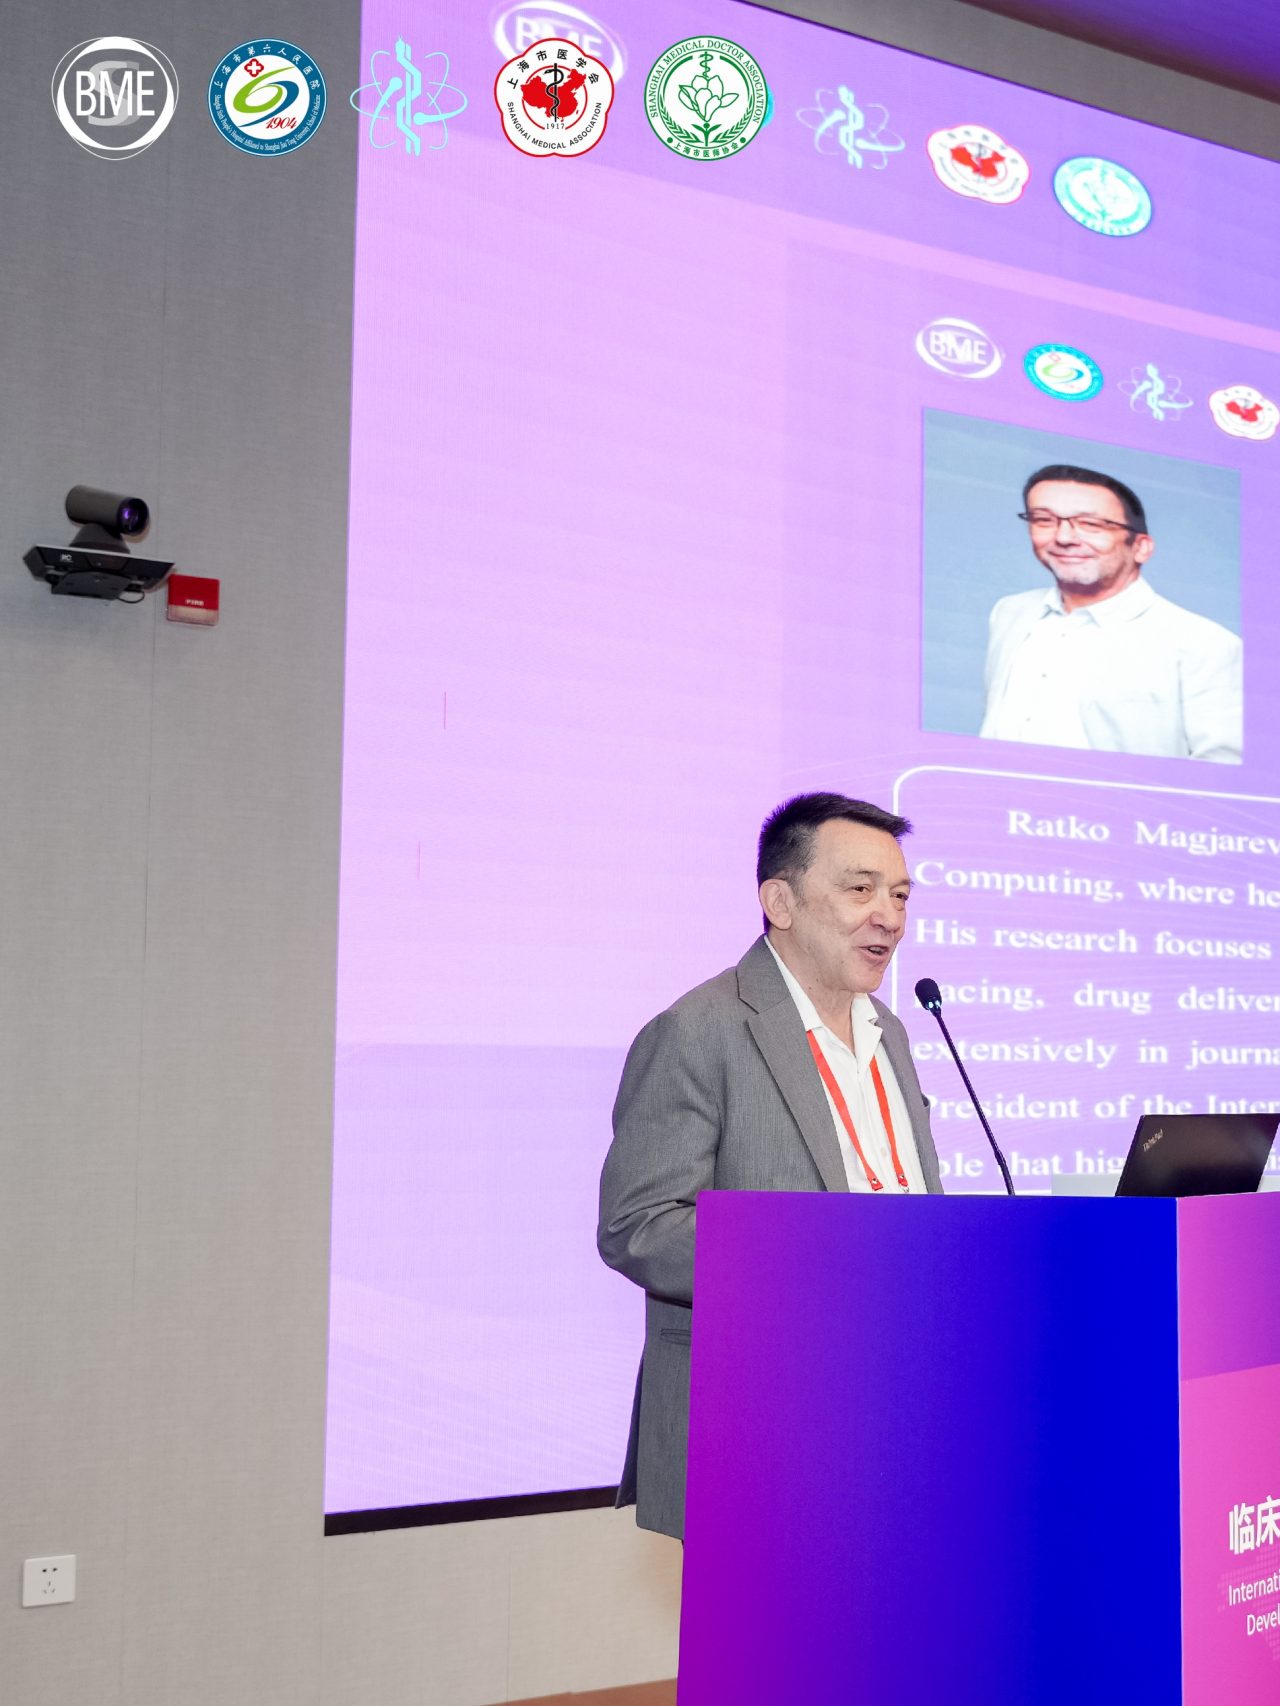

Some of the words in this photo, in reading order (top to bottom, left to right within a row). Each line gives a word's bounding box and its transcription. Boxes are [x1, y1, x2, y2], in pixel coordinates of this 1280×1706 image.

[929, 331, 987, 365] BME
[1007, 808, 1111, 843] Ratko
[914, 861, 1125, 904] Computing,
[1136, 876, 1236, 906] where
[914, 918, 977, 948] His
[992, 927, 1139, 954] research
[1154, 929, 1273, 961] focuses
[914, 978, 1046, 1013] acing,
[1073, 980, 1152, 1016] drug
